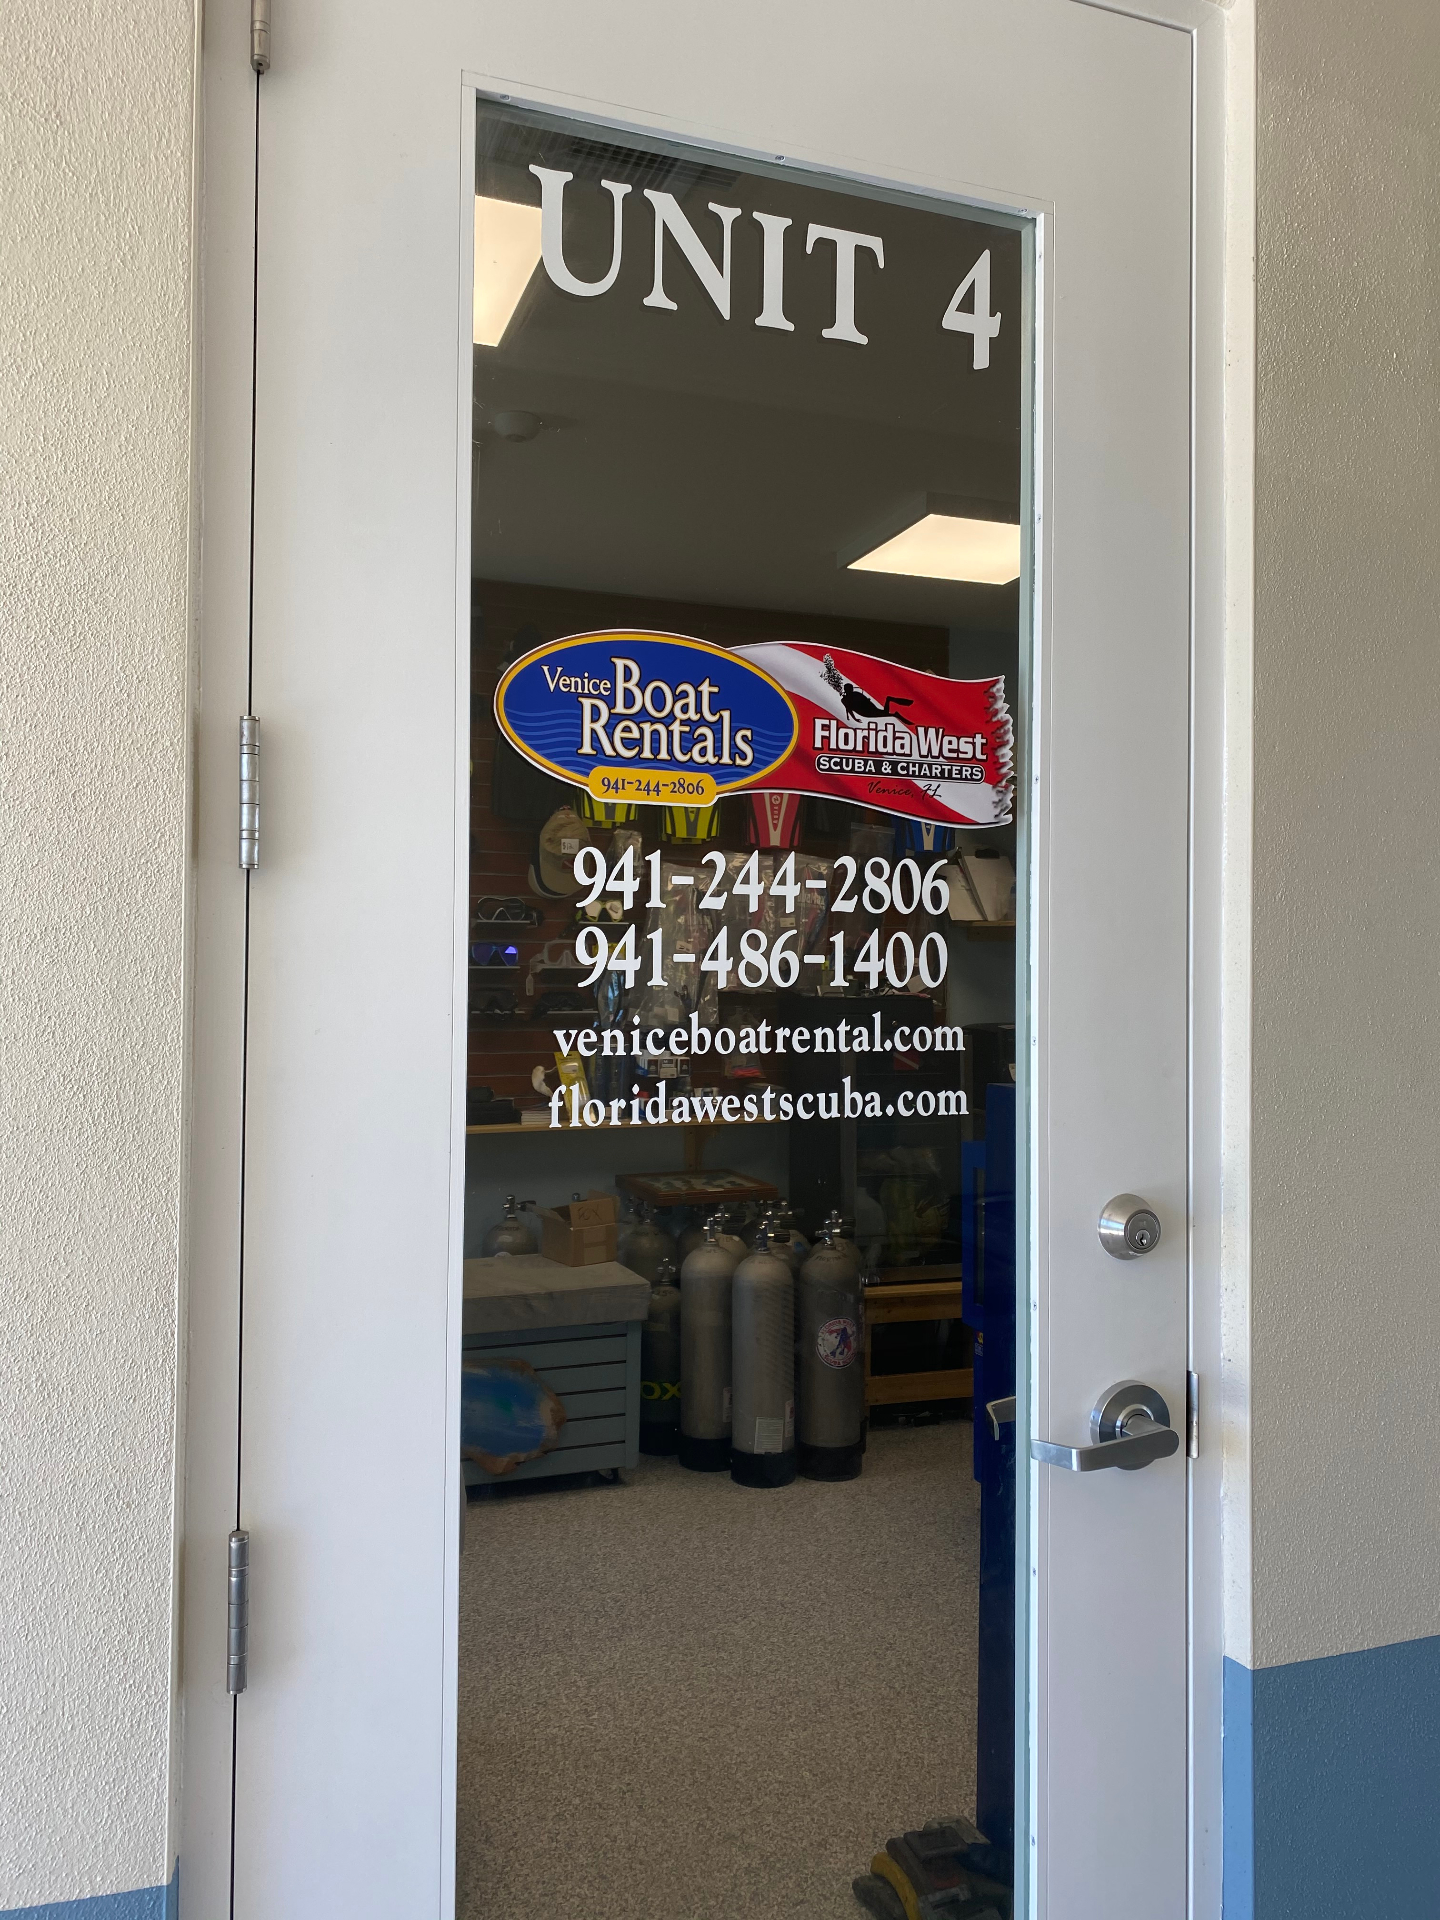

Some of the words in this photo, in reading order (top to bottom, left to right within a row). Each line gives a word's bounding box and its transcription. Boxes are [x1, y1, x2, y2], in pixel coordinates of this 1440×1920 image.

[528, 164, 884, 346] UNIT
[942, 249, 1002, 370] 4
[541, 665, 612, 696] Venice
[610, 657, 720, 723] Boat
[577, 696, 755, 767] Rentals
[813, 718, 912, 756] Florida
[916, 726, 988, 761] West
[601, 777, 706, 797] 941-244-2806
[819, 756, 876, 773] SCUBA
[881, 762, 892, 775] &
[897, 762, 983, 780] CHARTERS
[868, 781, 914, 798] Venice,
[920, 783, 942, 799] FL
[573, 844, 950, 915] 941-244-2806
[575, 924, 948, 989] 941-486-1400
[553, 1011, 966, 1058] veniceboatrental.com
[548, 1075, 969, 1129] floridawestscuba.com
